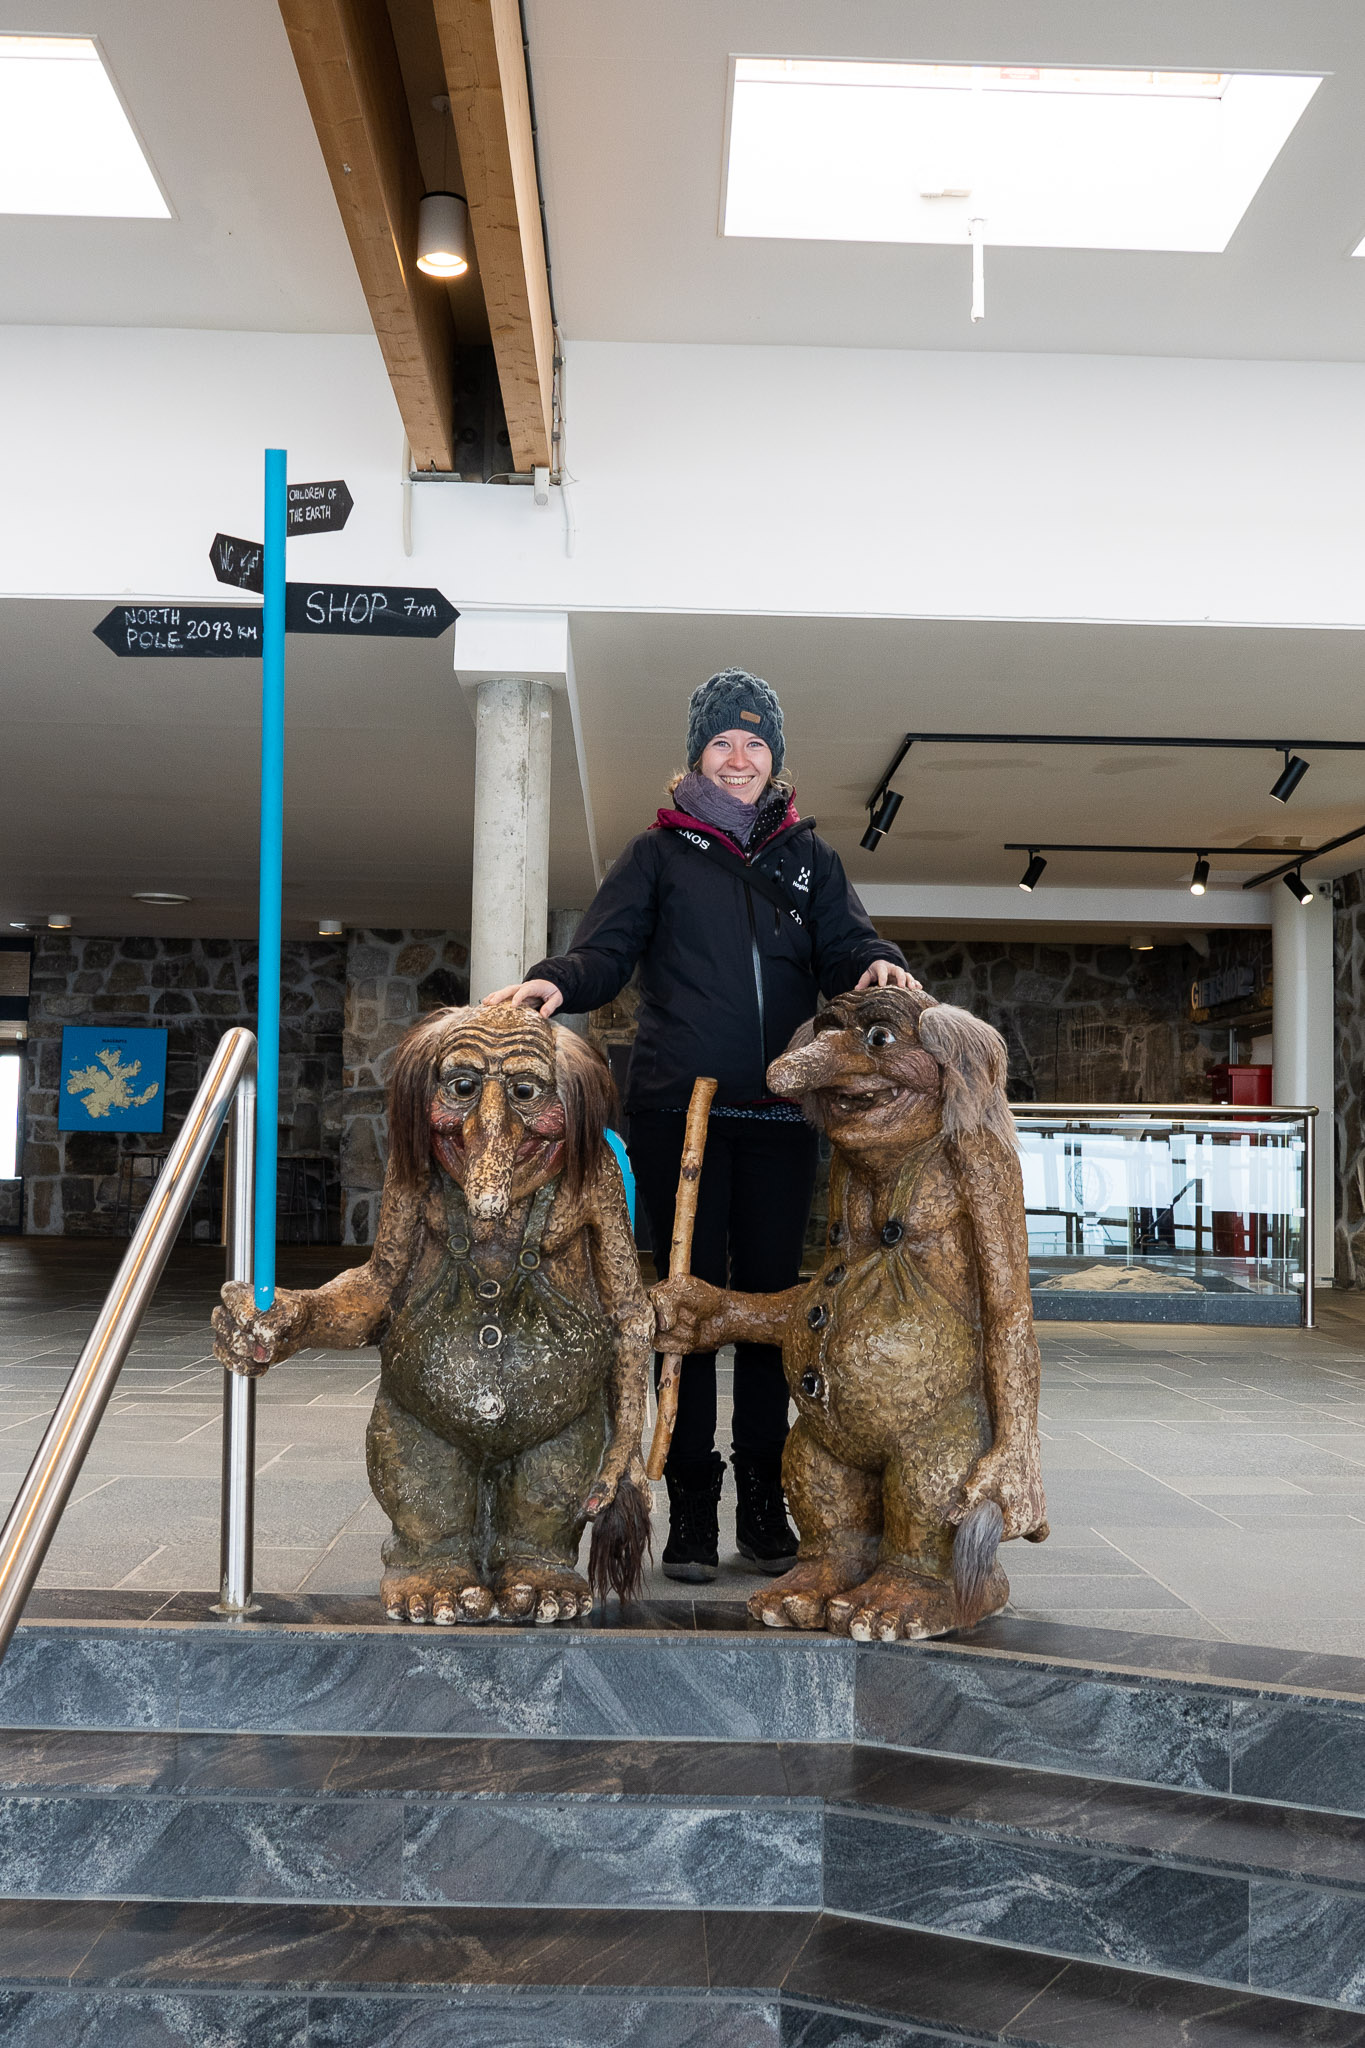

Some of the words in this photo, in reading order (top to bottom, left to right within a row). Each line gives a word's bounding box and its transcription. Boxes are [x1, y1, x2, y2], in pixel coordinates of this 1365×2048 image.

[289, 487, 325, 501] CHILDREN
[328, 488, 337, 500] OF
[289, 507, 304, 524] THE
[305, 505, 331, 521] EARTH
[219, 541, 234, 572] WC
[125, 608, 180, 626] NORTH
[306, 591, 388, 624] SHOP
[127, 627, 183, 650] POLE
[187, 620, 232, 641] 2093
[237, 625, 257, 640] KM
